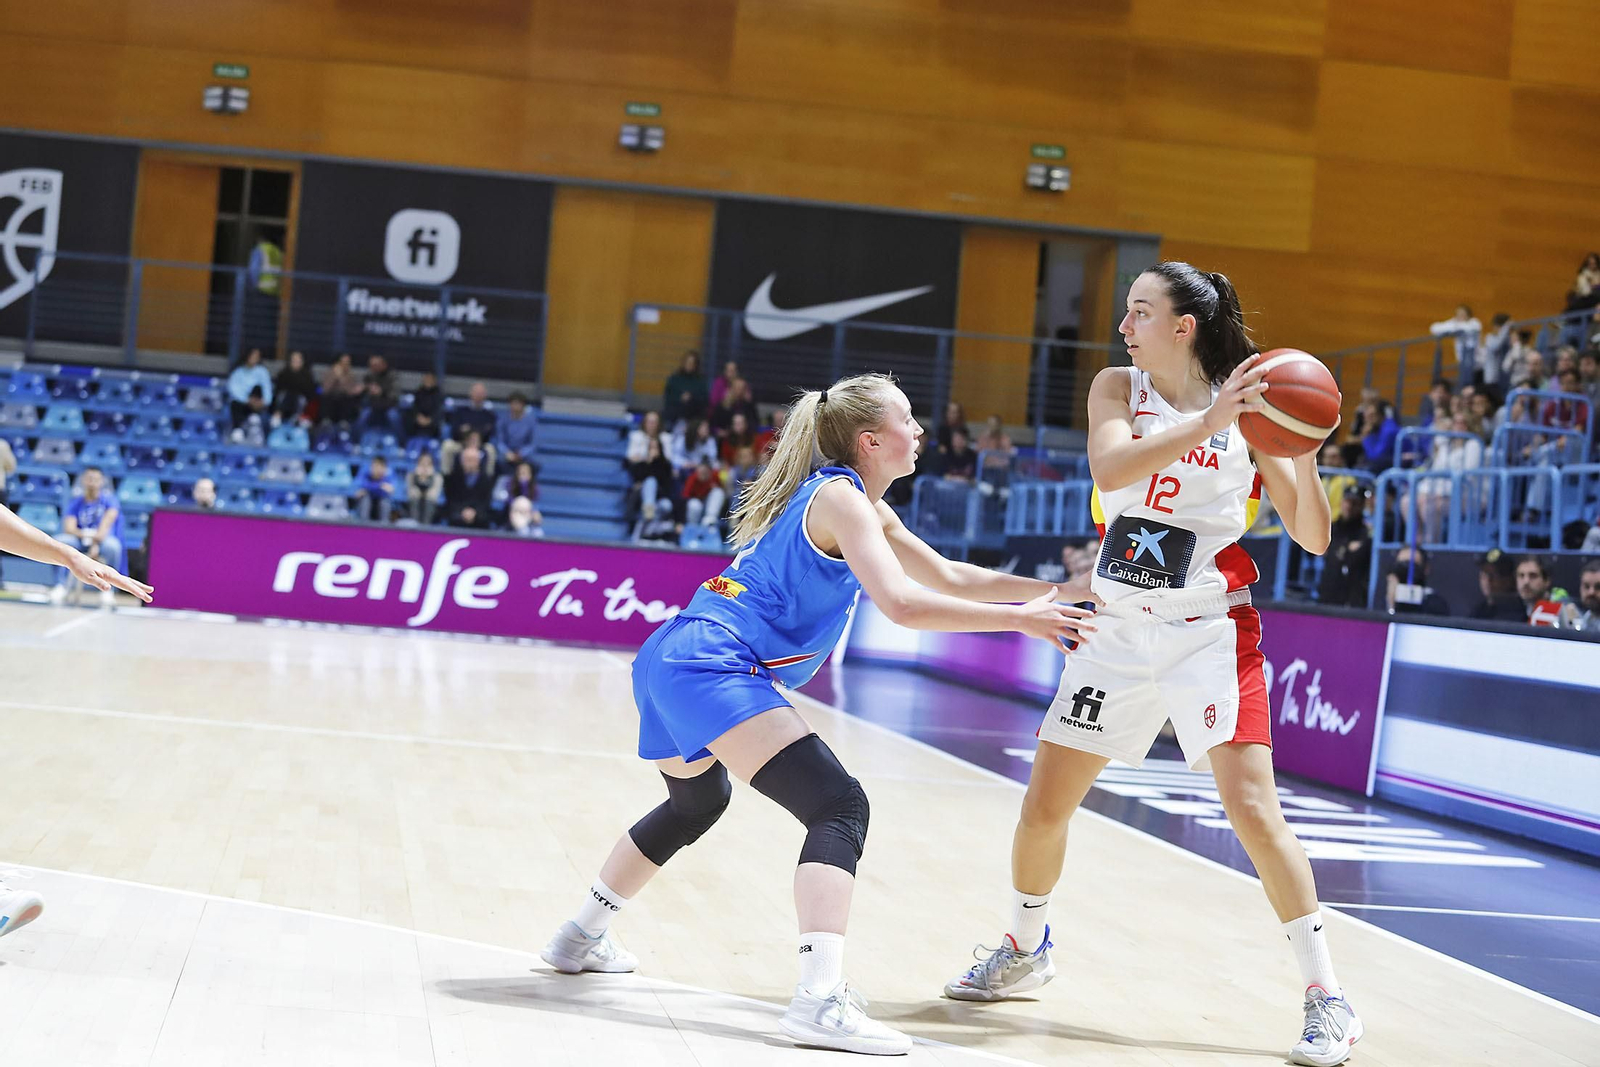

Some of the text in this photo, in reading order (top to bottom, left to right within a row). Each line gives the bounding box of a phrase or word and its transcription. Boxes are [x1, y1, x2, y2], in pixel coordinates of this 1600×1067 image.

[21, 178, 53, 194] FEB
[407, 227, 438, 266] fi
[1145, 472, 1181, 514] 12
[273, 538, 509, 627] renfe
[530, 567, 598, 618] Tu
[1107, 561, 1172, 589] CaixaBank
[1071, 685, 1106, 723] fi
[1278, 658, 1308, 725] Tu
[1060, 715, 1104, 732] network
